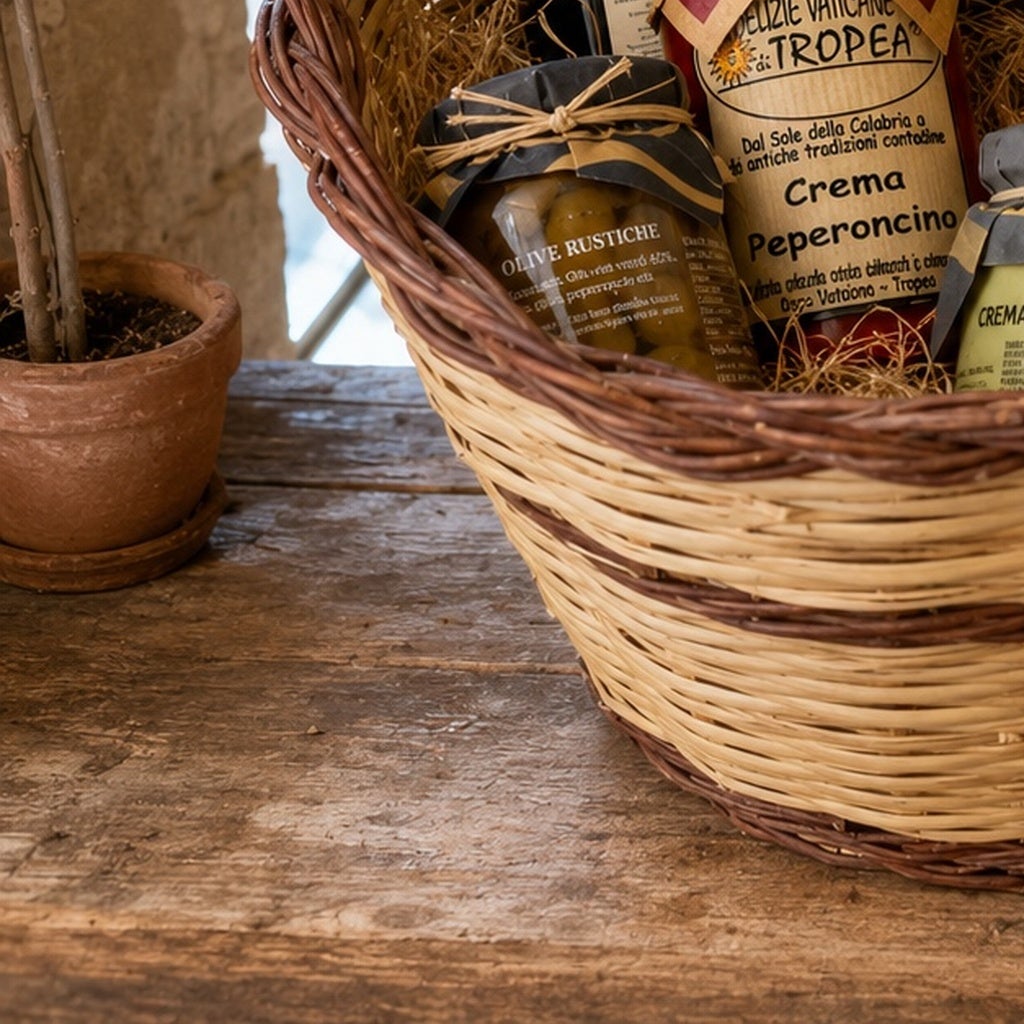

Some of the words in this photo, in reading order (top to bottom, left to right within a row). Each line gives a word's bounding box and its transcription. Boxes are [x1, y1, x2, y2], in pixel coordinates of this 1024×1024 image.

[768, 22, 911, 69] TROPEA
[741, 133, 765, 155] Dal
[770, 127, 802, 148] Sole
[808, 120, 845, 140] della
[850, 112, 912, 134] Calabria
[918, 115, 925, 127] a
[747, 148, 799, 172] antiche
[804, 134, 877, 159] tradizioni
[784, 170, 906, 206] Crema
[501, 244, 562, 277] OLIVE
[565, 223, 661, 257] RUSTICHE
[747, 204, 958, 262] Peperoncino
